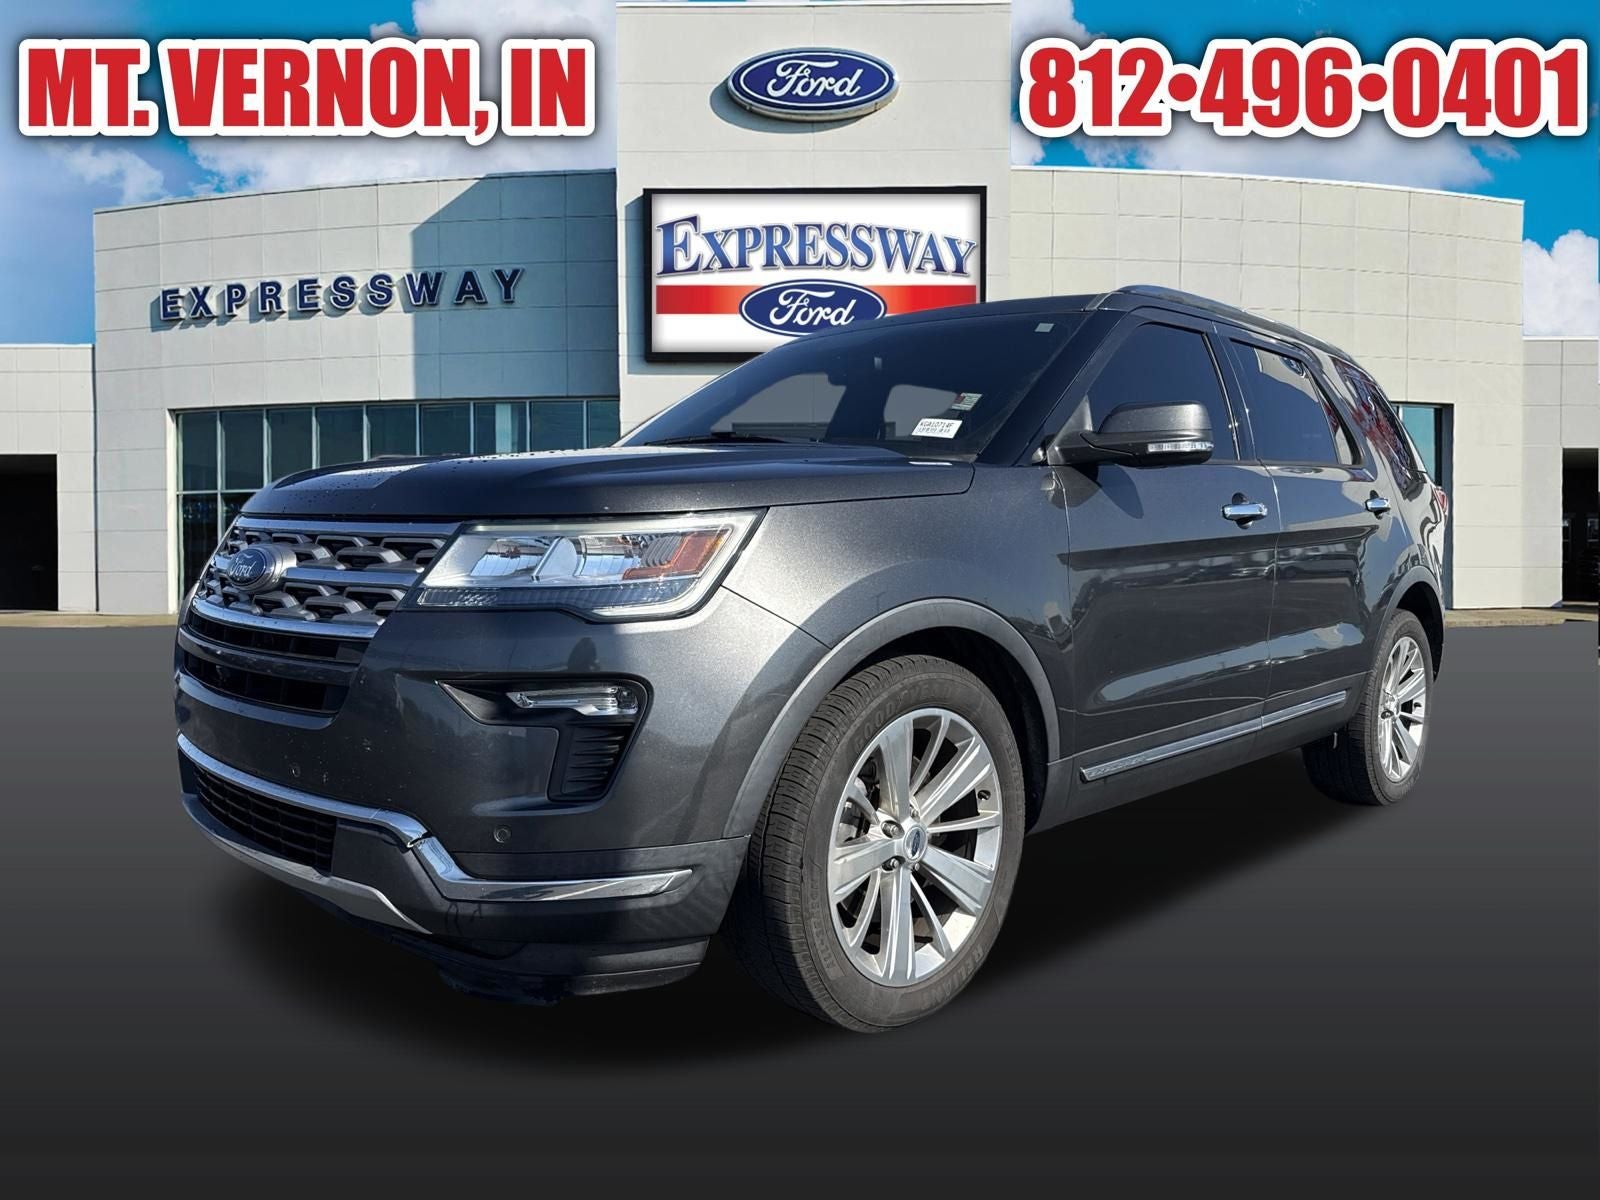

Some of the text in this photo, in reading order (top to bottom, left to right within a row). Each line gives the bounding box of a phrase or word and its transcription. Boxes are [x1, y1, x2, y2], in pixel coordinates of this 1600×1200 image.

[766, 59, 864, 97] Ford
[159, 267, 525, 320] EXPRESSWAY
[769, 288, 857, 326] Ford
[230, 552, 258, 577] Ford
